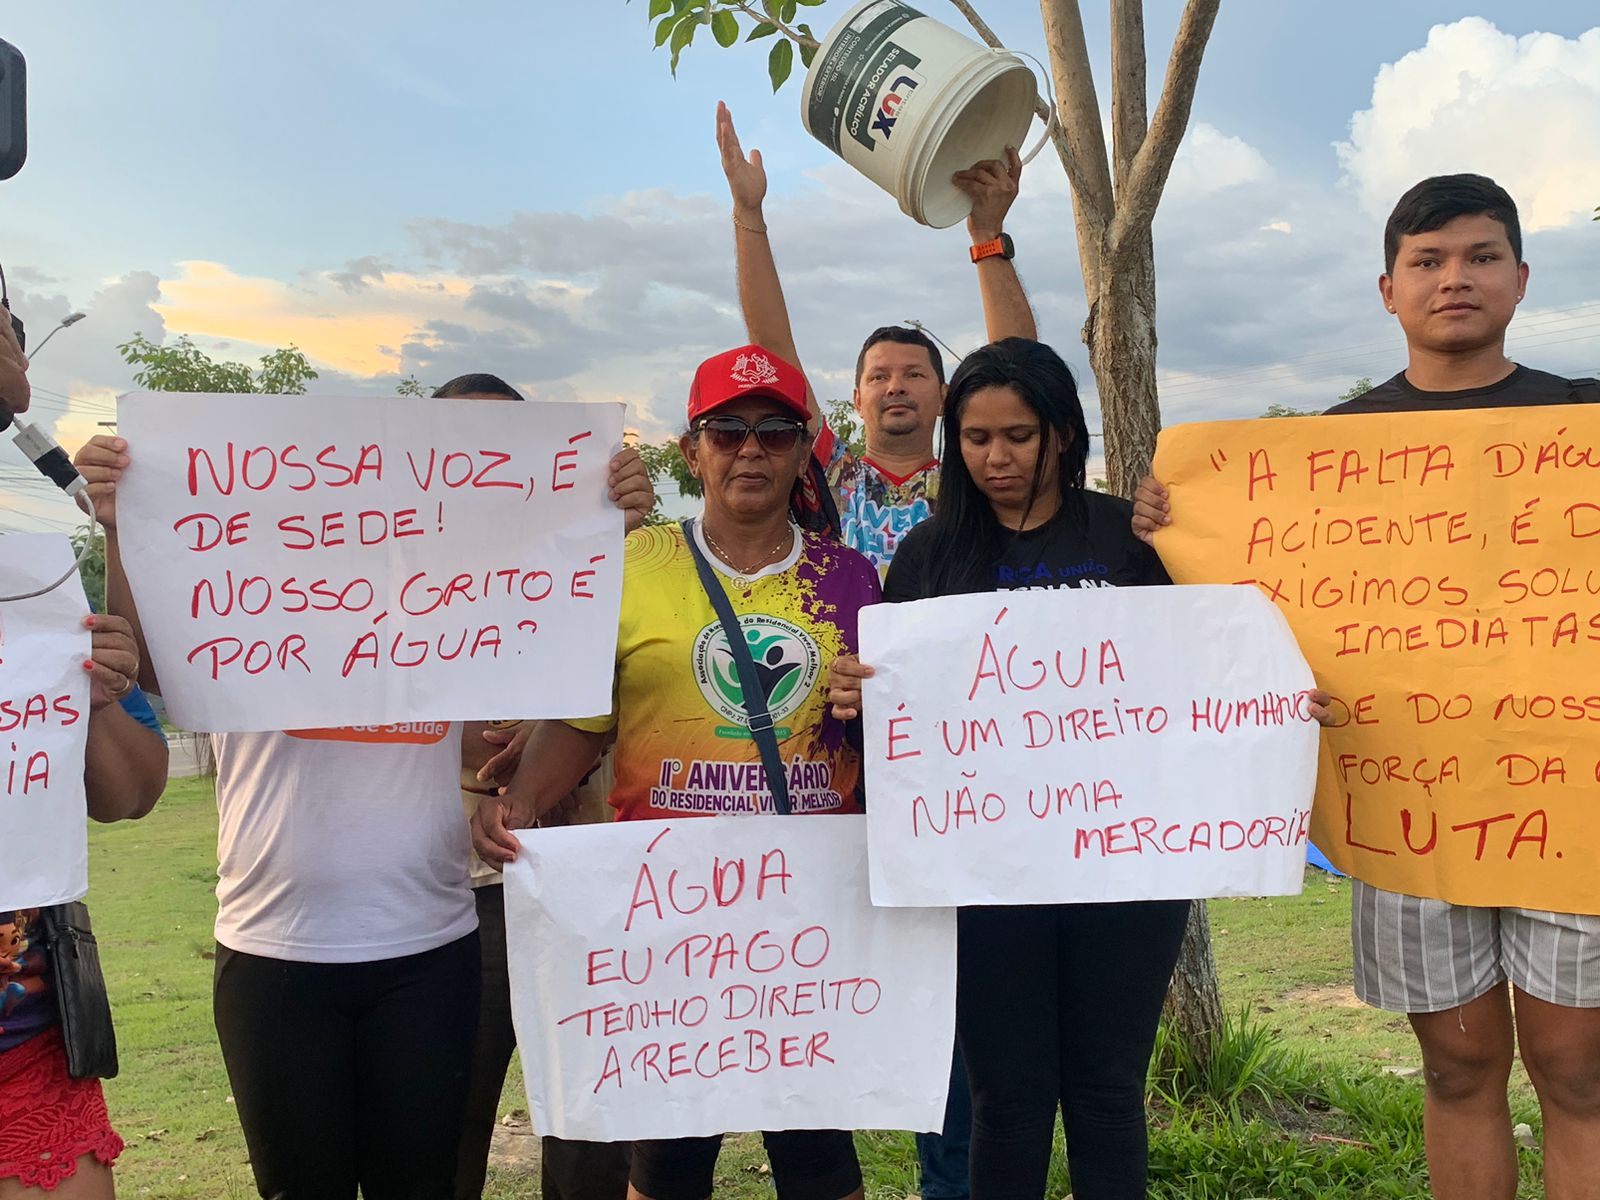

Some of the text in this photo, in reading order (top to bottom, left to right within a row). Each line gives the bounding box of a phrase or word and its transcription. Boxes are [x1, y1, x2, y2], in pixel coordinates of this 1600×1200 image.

[831, 33, 852, 63] INTERIOR
[867, 48, 900, 90] SELADOR
[850, 89, 871, 136] ACRÍLICO
[188, 431, 593, 502] NOSSA VOZ, É
[1306, 444, 1456, 493] FALTA
[173, 502, 445, 553] DE SEDE!
[1246, 508, 1488, 565] ACIDENTE,
[1510, 497, 1542, 546] É
[191, 554, 608, 620] NOSSO GRITO É
[187, 611, 538, 681] POR ÁGUA?
[756, 617, 799, 636] Residencial
[798, 631, 812, 650] Viver
[808, 650, 818, 681] Melhor
[969, 607, 1125, 701] ÁGUA
[886, 703, 923, 761] É
[942, 718, 1003, 757] UM
[1023, 698, 1169, 749] DIREITO
[1406, 694, 1473, 724] DO
[651, 791, 667, 807] DO
[669, 792, 754, 812] RESIDENCIAL
[802, 793, 842, 810] MELHOR
[687, 756, 830, 793] ANIVERÁRIO
[913, 771, 1123, 837] NÃO UMA
[1338, 753, 1461, 797] FORÇA
[1495, 753, 1567, 785] DA
[1073, 808, 1309, 860] MERCADORIA
[1345, 790, 1564, 862] LUTA.
[587, 926, 830, 986] EU PAGO
[557, 977, 882, 1038] TENHO DIREITO
[594, 1029, 836, 1094] A RECEBER
